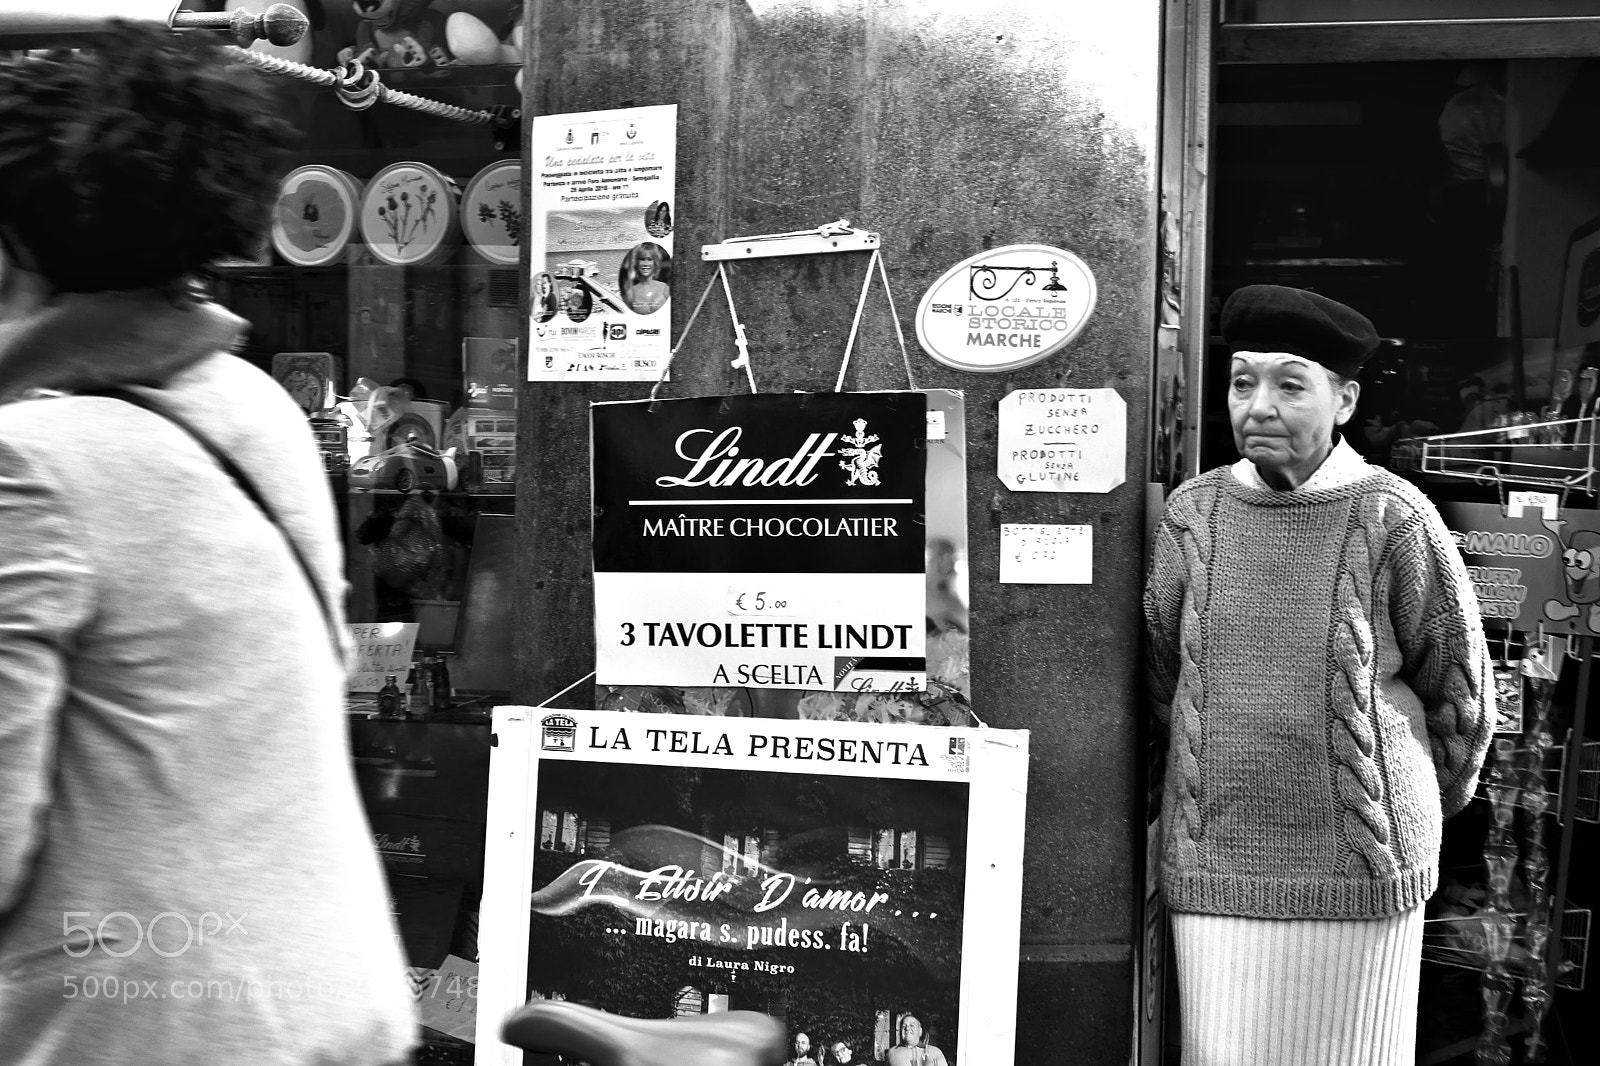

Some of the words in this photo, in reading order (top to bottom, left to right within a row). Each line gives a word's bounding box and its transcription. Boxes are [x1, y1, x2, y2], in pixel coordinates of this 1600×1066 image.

[967, 304, 1067, 319] LOCALE
[968, 317, 1068, 331] STORICO
[966, 332, 1041, 348] MARCHE
[1018, 392, 1091, 405] PRODOTTI
[1046, 407, 1087, 418] SENZA
[1024, 424, 1099, 436] ZUCCHERO
[655, 426, 838, 487] Lindt
[1012, 450, 1082, 461] PRODOTTI
[1016, 472, 1080, 484] GLUTINE
[642, 513, 725, 537] MAÎTRE
[730, 517, 899, 537] CHOCOLATIER
[735, 592, 748, 611] €
[755, 591, 788, 611] 5.00
[620, 622, 636, 647] 3
[643, 622, 808, 649] TAVOLETTE
[818, 623, 913, 650] LINDT
[712, 663, 730, 684] A
[737, 663, 824, 686] SCELTA
[588, 726, 632, 751] LA
[646, 728, 734, 756] TELA
[747, 734, 930, 767] PRESENTA
[635, 917, 712, 943] magara
[719, 922, 738, 943] s.
[747, 917, 831, 950] pudess.
[840, 921, 870, 953] fa!
[688, 955, 702, 967] di
[706, 957, 750, 971] Laura
[754, 960, 795, 975] Nigro
